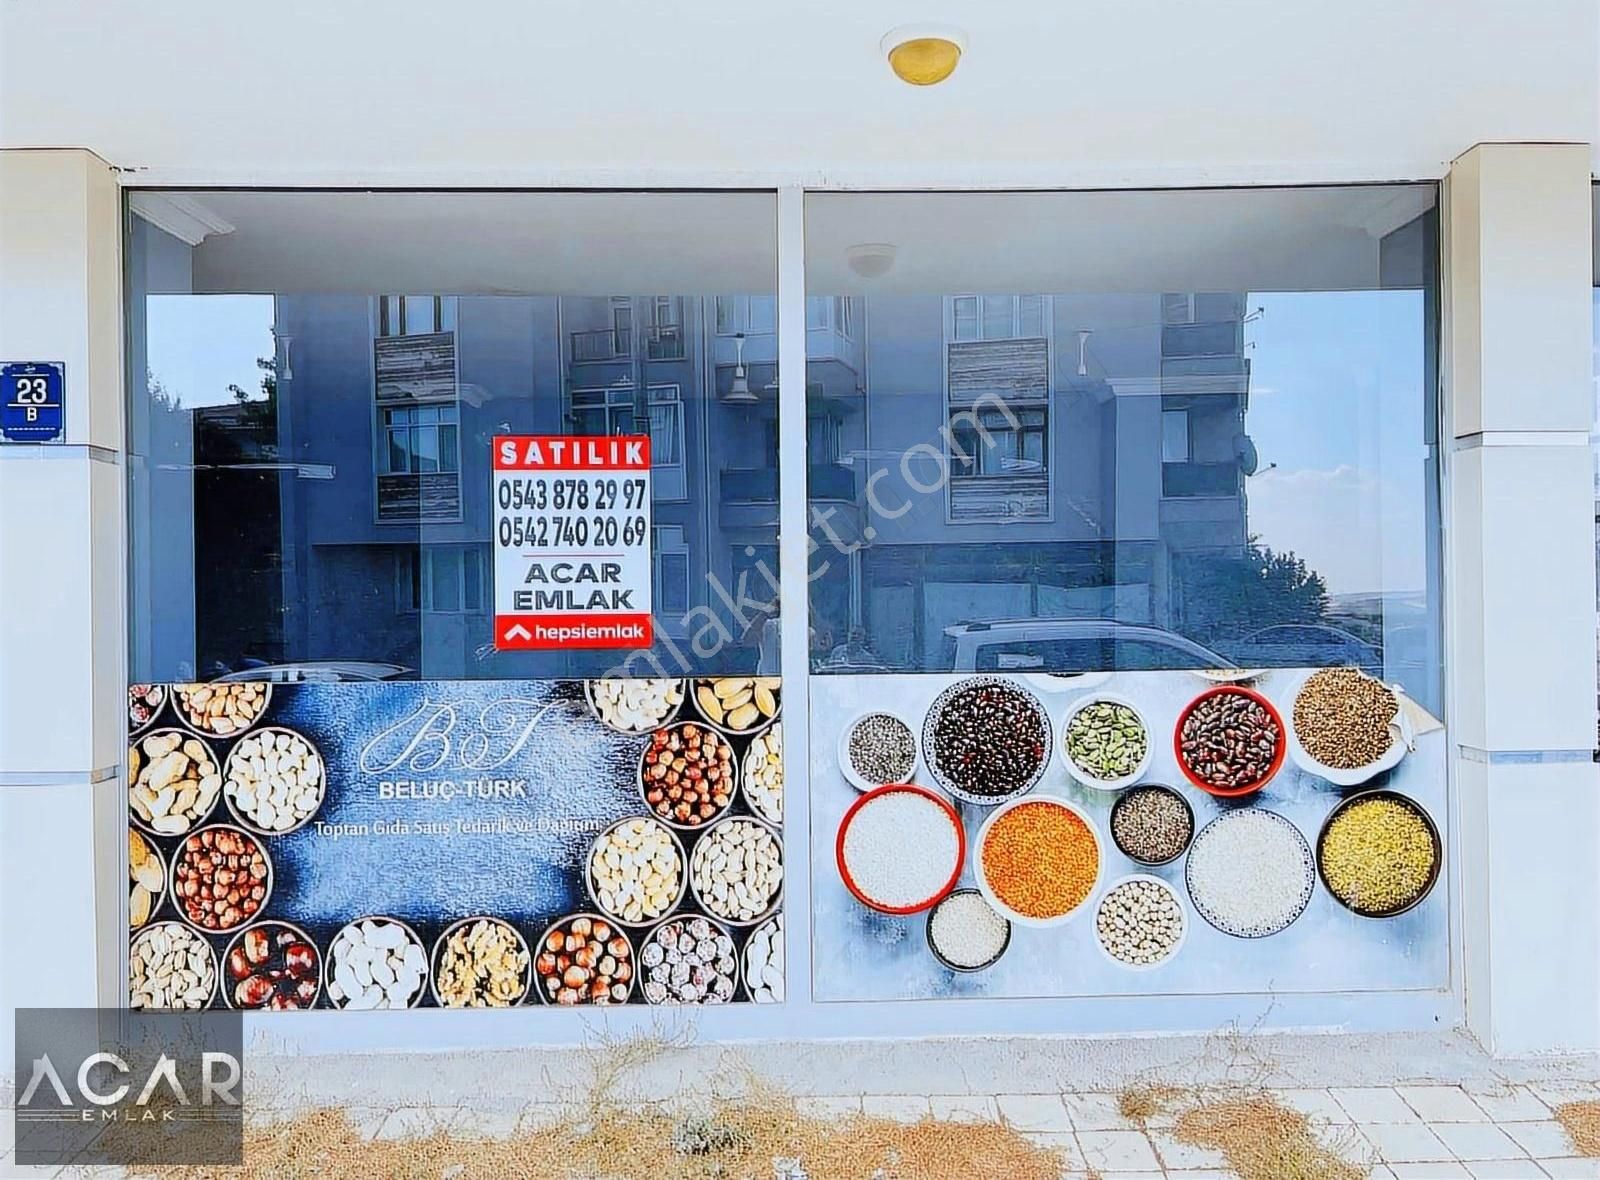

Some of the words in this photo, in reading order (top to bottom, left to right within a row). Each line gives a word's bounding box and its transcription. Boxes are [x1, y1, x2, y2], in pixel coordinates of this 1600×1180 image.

[17, 378, 47, 404] 23
[27, 407, 37, 422] B
[500, 441, 644, 465] SATILIK
[499, 479, 547, 510] 0543
[553, 479, 589, 510] 878
[595, 479, 618, 510] 29
[623, 479, 646, 510] 97
[499, 516, 549, 547] 0542
[552, 516, 589, 547] 740
[594, 516, 618, 546] 20
[623, 516, 646, 546] 69
[524, 562, 622, 584] ACAR
[513, 589, 634, 611] EMLAK
[535, 623, 645, 642] hepsiemlak
[314, 821, 369, 840] Toptan
[373, 818, 409, 835] Gıda
